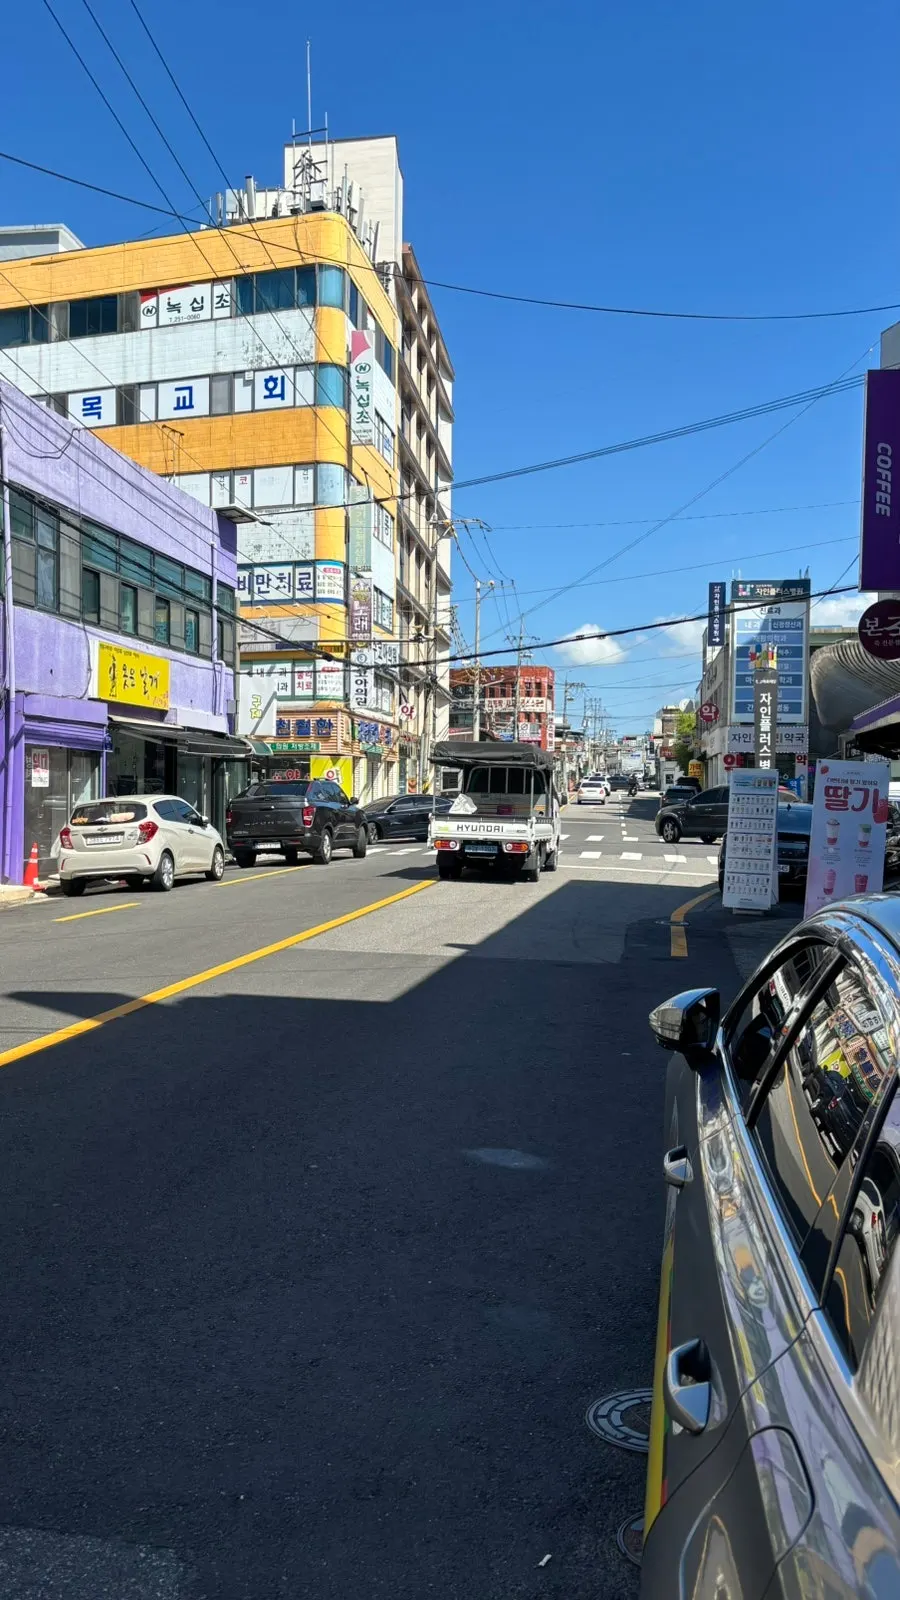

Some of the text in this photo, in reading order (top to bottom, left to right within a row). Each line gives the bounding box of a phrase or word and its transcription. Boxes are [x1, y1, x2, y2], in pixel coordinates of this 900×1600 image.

[875, 442, 892, 517] COFFEE
[237, 572, 313, 595] 비만치료
[401, 705, 416, 720] 약
[824, 785, 881, 814] 딸기
[456, 824, 504, 833] HYUNDAI
